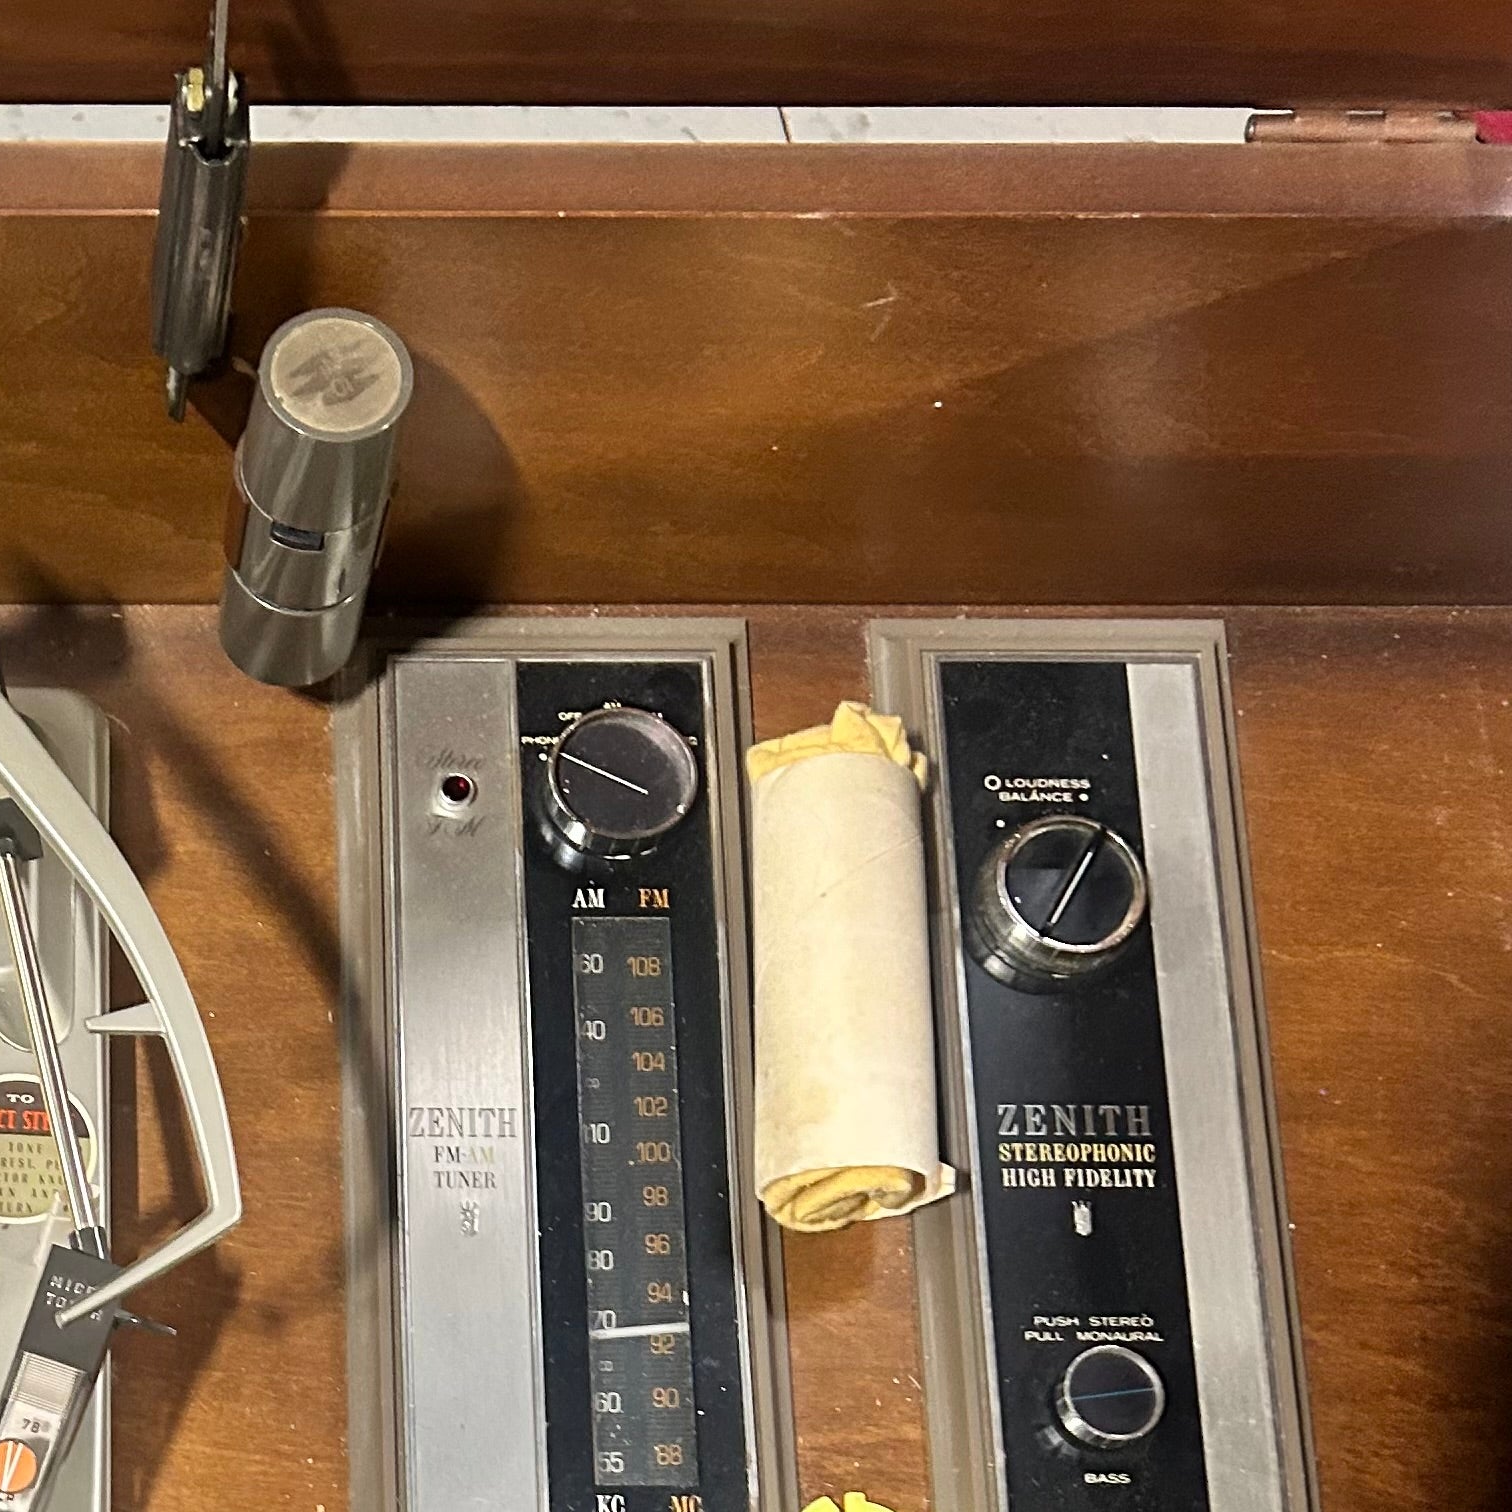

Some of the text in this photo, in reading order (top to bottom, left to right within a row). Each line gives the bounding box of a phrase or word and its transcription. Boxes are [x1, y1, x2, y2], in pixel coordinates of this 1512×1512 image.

[521, 736, 560, 745] PHON
[1004, 778, 1091, 789] LOUDNESS
[998, 790, 1073, 803] BALANCE
[572, 888, 670, 908] AM FM
[627, 956, 662, 977] 108
[630, 1007, 665, 1027] 106
[632, 1052, 665, 1072] 104
[6, 1094, 34, 1104] TO
[633, 1097, 668, 1117] 102
[408, 1107, 518, 1138] ZENITH
[996, 1104, 1153, 1136] ZENITH
[434, 1145, 496, 1164] FM-AM
[636, 1142, 672, 1162] 100
[998, 1142, 1157, 1163] STEREOPHONIC
[433, 1170, 497, 1189] TUNER
[1001, 1168, 1157, 1188] HIGH FIDELITY
[643, 1186, 669, 1206] 98
[585, 1201, 612, 1222] 90
[644, 1234, 670, 1254] 96
[588, 1250, 614, 1270] 80
[647, 1282, 673, 1303] 94
[591, 1310, 617, 1330] 70
[1033, 1315, 1154, 1328] PUSH STEREO
[650, 1334, 676, 1355] 92
[1024, 1330, 1165, 1342] PULL MONAURAL
[596, 1392, 622, 1413] 60
[652, 1387, 680, 1408] 90
[22, 1417, 41, 1434] 78
[598, 1451, 624, 1473] 55
[656, 1444, 683, 1466] 88
[1085, 1473, 1131, 1486] BASS
